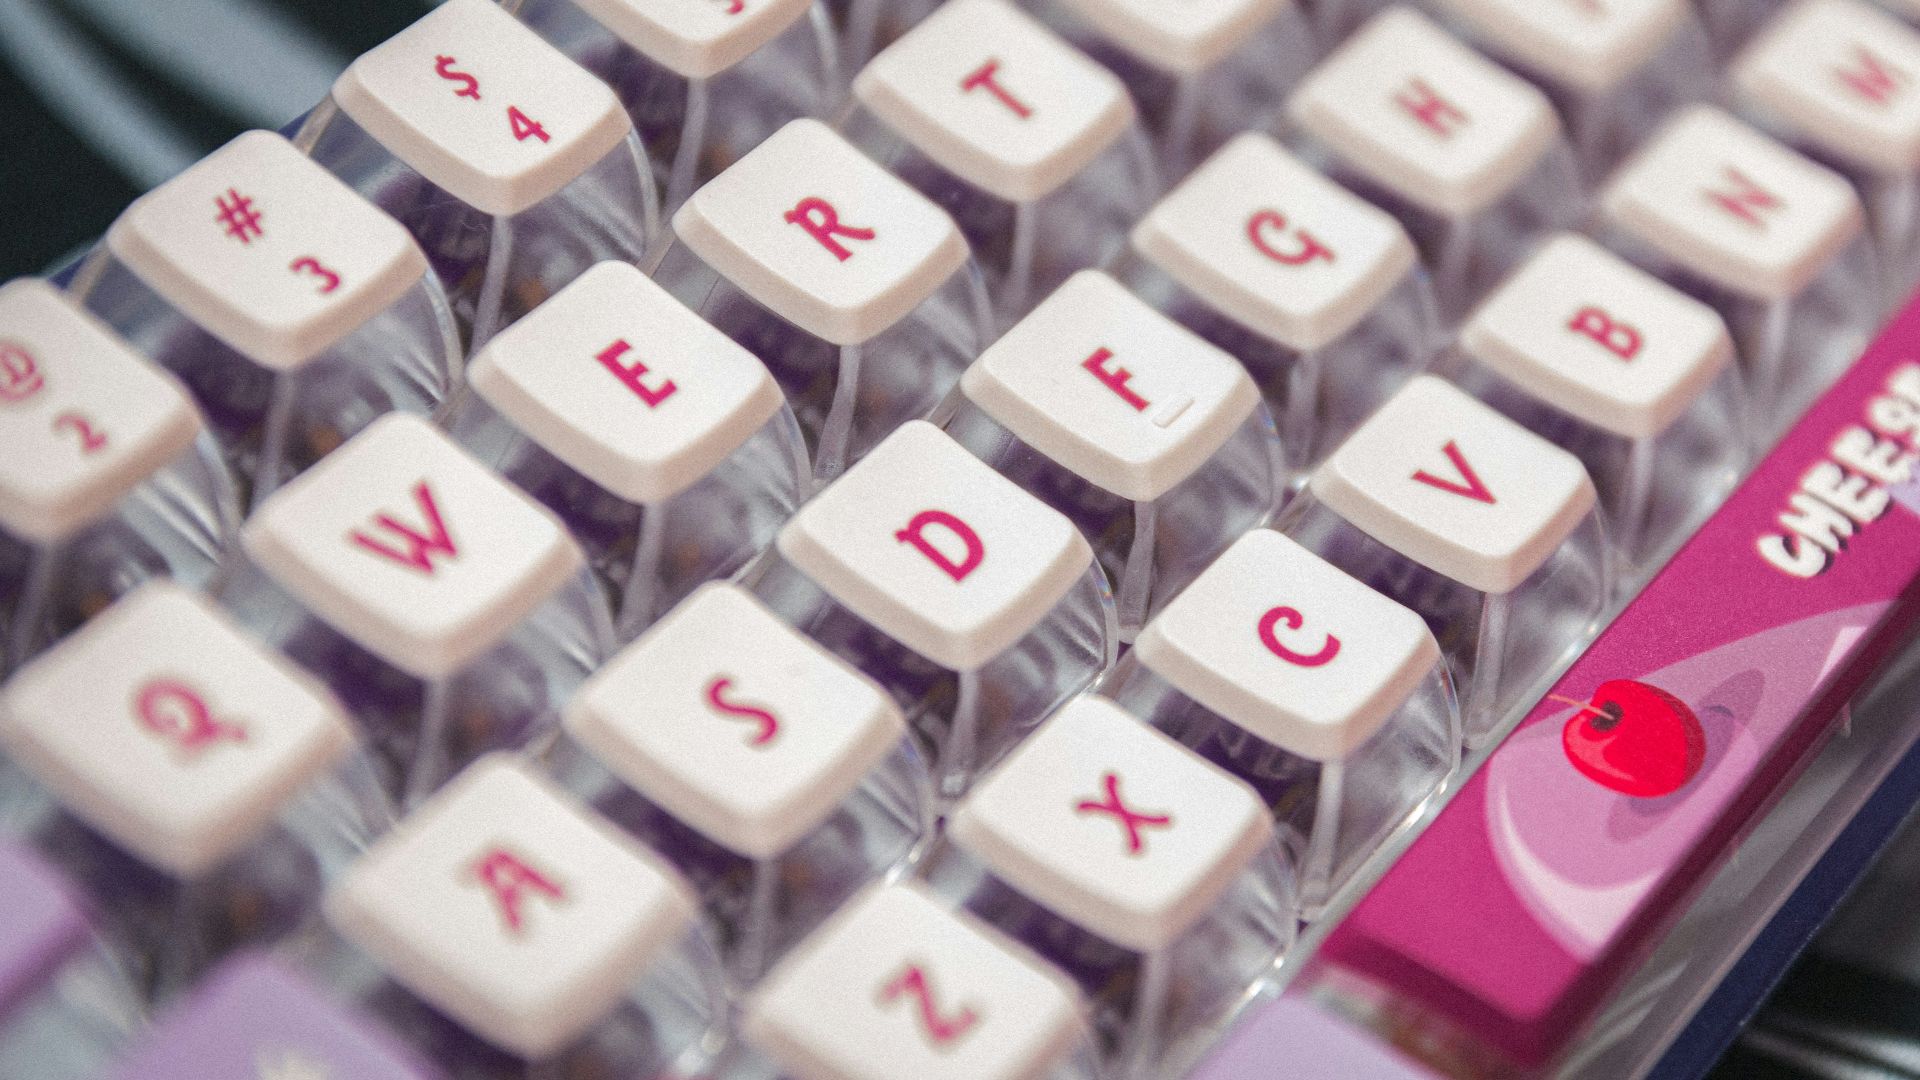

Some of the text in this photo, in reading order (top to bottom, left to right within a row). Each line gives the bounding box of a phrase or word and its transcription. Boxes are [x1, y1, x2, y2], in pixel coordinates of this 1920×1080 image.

[434, 54, 482, 101] $
[961, 60, 1033, 119] T
[507, 105, 551, 144] 4
[215, 188, 263, 244] #
[1706, 168, 1782, 225] N
[783, 196, 876, 263] R
[1245, 210, 1335, 266] G
[290, 256, 342, 294] 3
[1567, 307, 1643, 361] B
[595, 338, 678, 409] E
[1081, 347, 1151, 412] F
[55, 413, 108, 453] 2
[1411, 440, 1496, 505] V
[350, 481, 460, 575] W
[893, 508, 986, 584] D
[1256, 604, 1342, 669] C
[134, 679, 248, 754] Q
[704, 677, 781, 746] S
[1075, 772, 1172, 855] X
[468, 846, 565, 933] A
[879, 965, 979, 1045] Z
